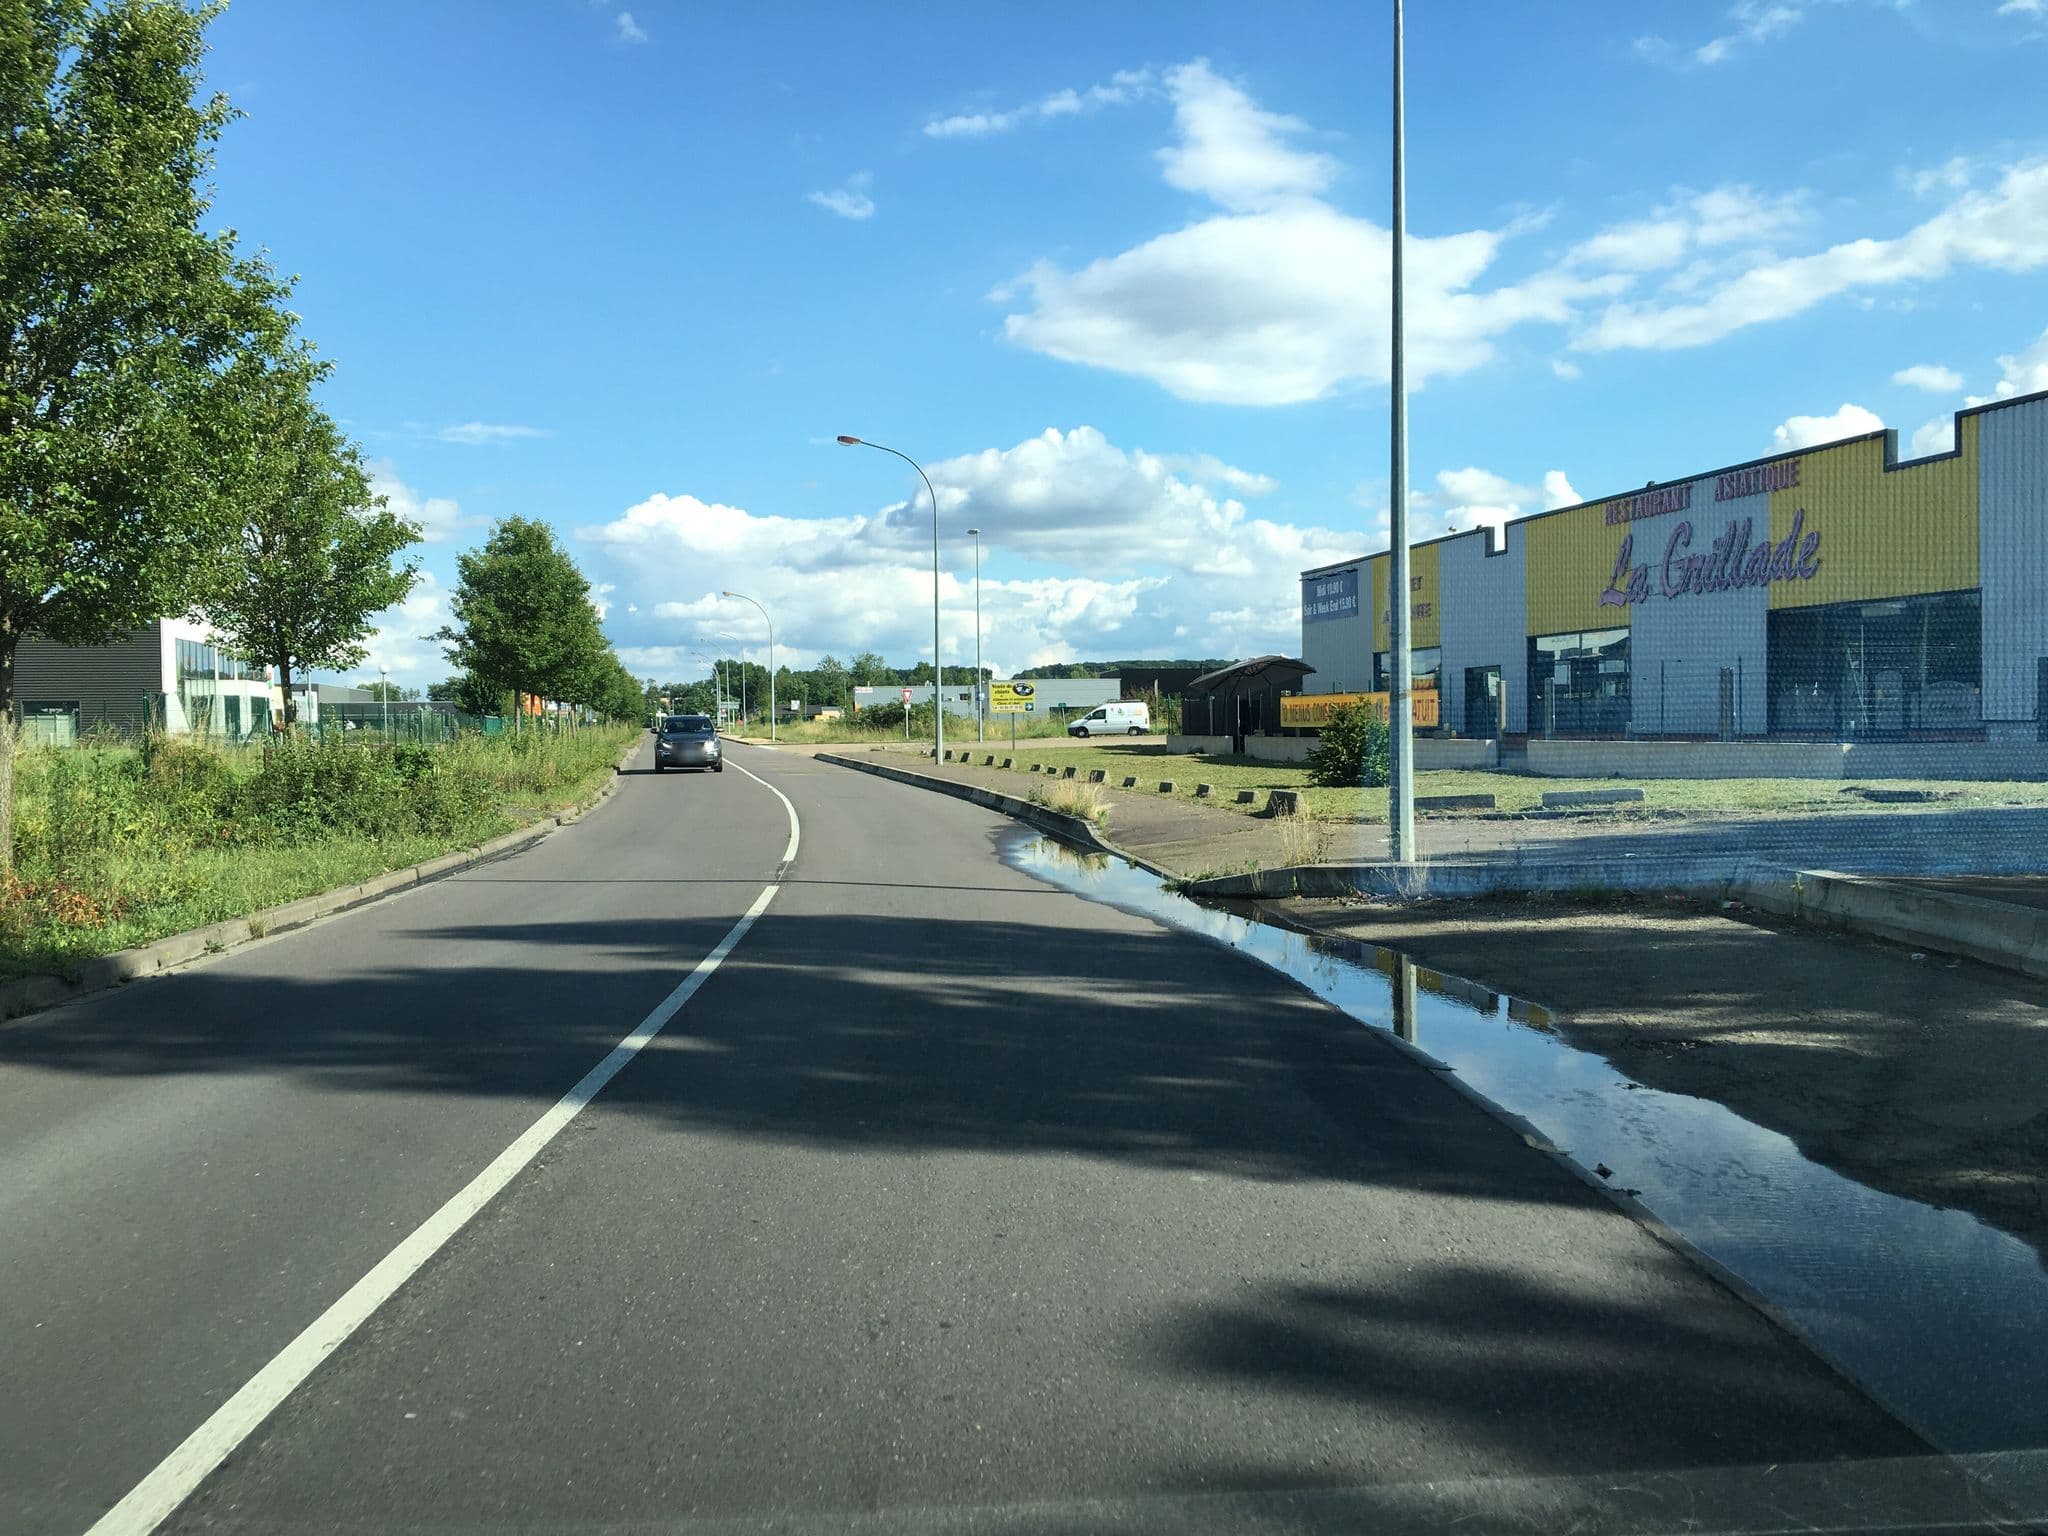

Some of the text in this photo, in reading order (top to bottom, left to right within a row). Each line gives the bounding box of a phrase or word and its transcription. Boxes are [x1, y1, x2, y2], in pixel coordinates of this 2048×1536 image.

[1605, 460, 1800, 525] RESTAURANT ASIATIQUE
[1599, 508, 1821, 607] La Grillade
